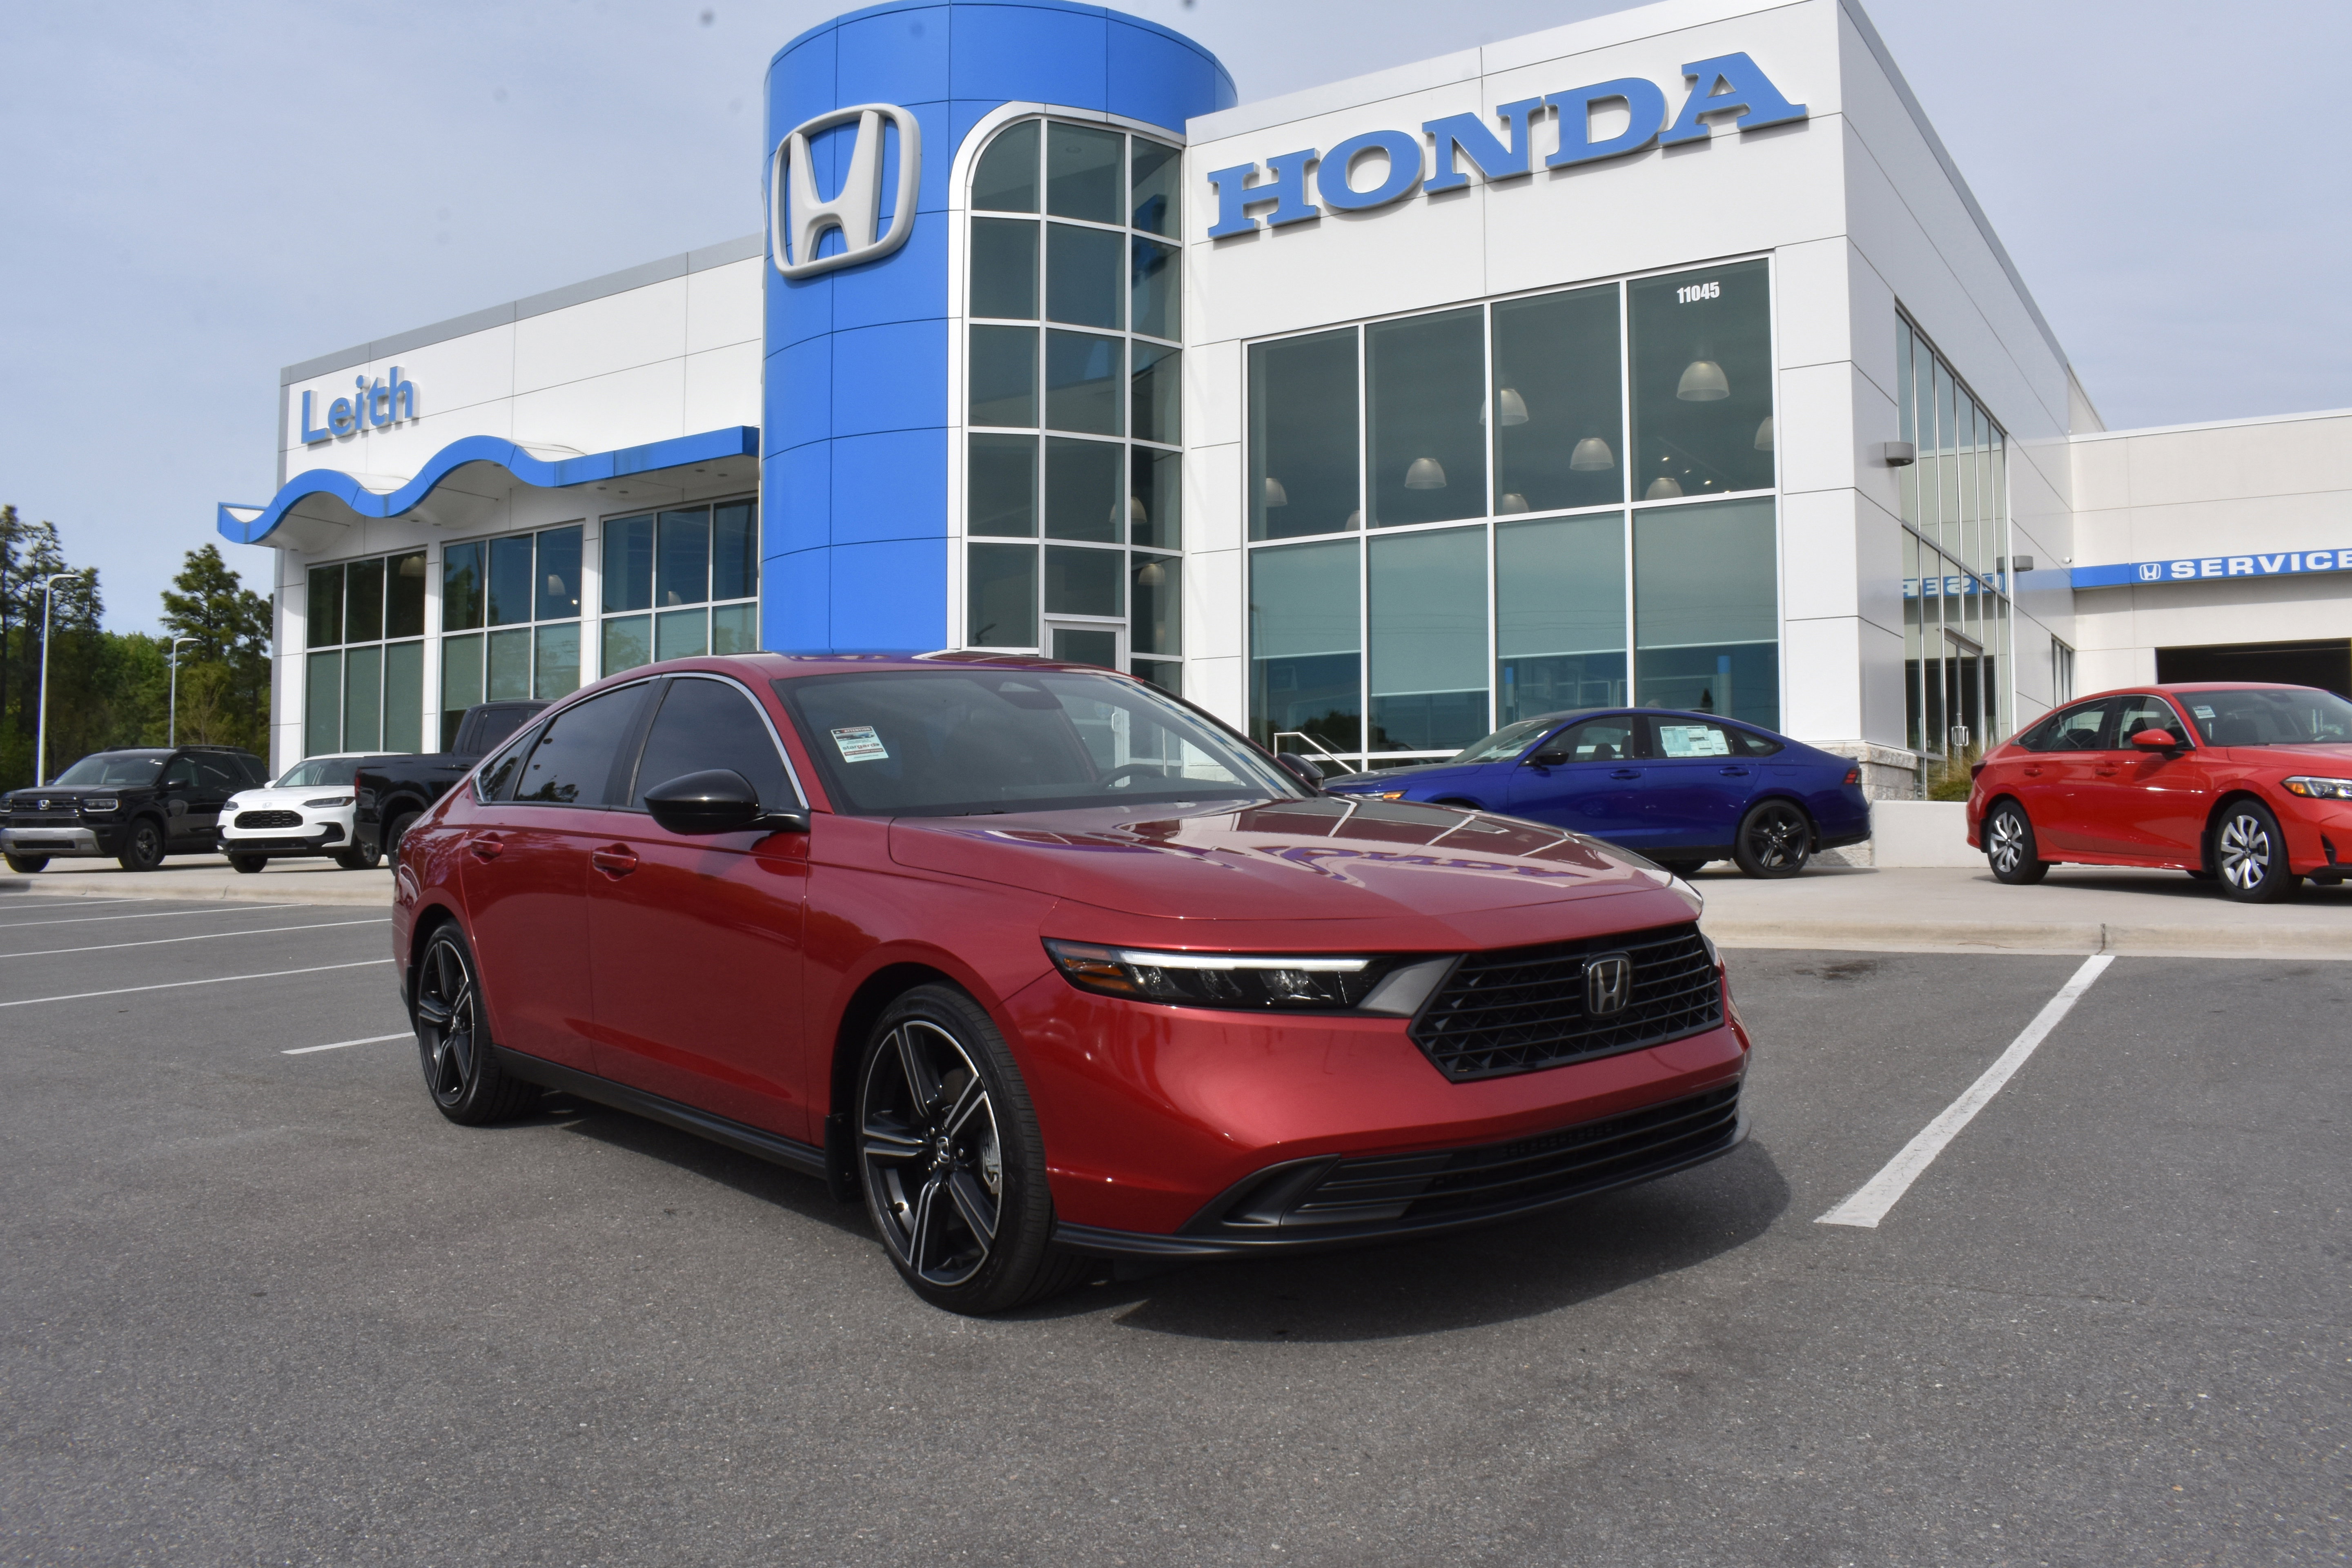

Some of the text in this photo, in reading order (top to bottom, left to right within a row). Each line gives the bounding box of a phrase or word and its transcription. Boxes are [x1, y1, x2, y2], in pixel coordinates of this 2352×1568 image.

[1207, 51, 1808, 239] HONDA
[1677, 282, 1720, 303] 11045
[301, 366, 416, 443] Leith
